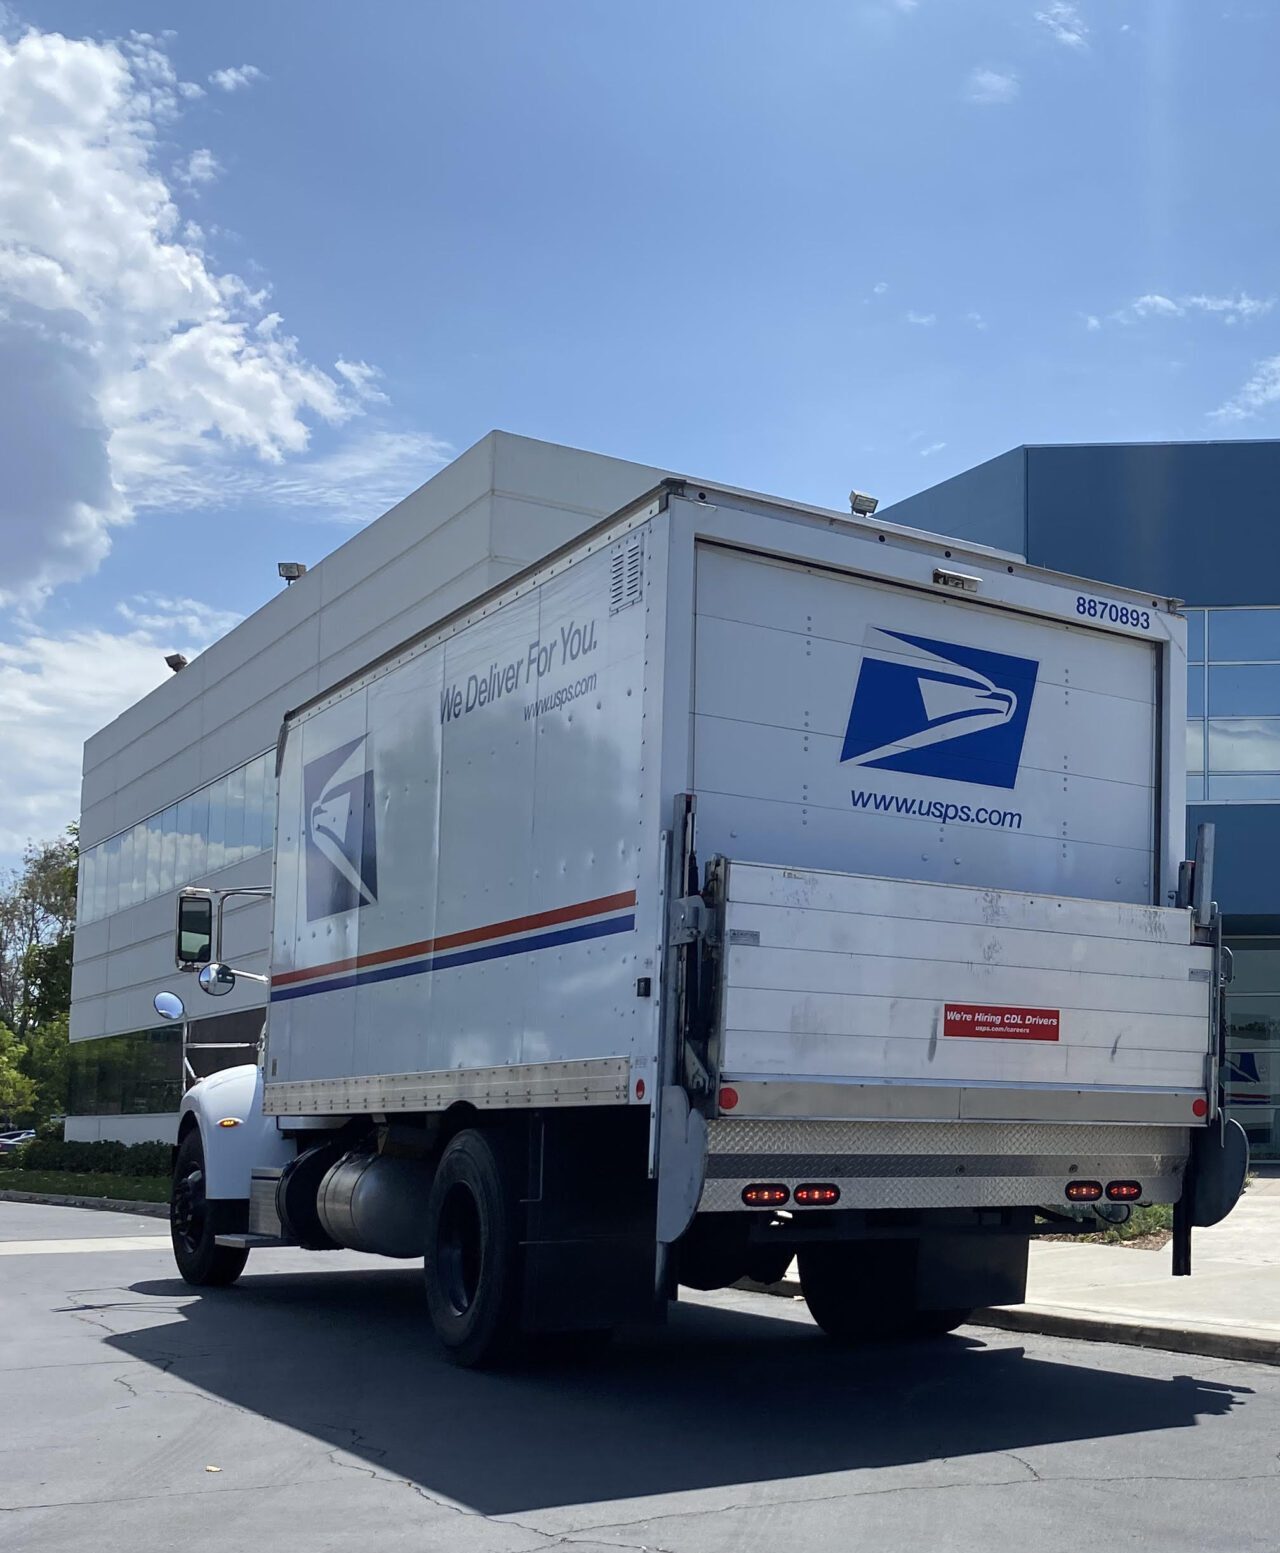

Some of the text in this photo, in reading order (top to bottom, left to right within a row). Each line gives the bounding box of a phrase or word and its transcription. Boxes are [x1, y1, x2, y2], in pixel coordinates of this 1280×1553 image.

[1075, 596, 1150, 630] 8870893
[440, 620, 597, 725] We Deliver For You.
[523, 672, 597, 721] www.usps.com
[850, 789, 1023, 830] www.usps.com
[946, 1011, 1058, 1026] We're Hiring CDL Drivers
[975, 1025, 1030, 1034] usps.com/careers
